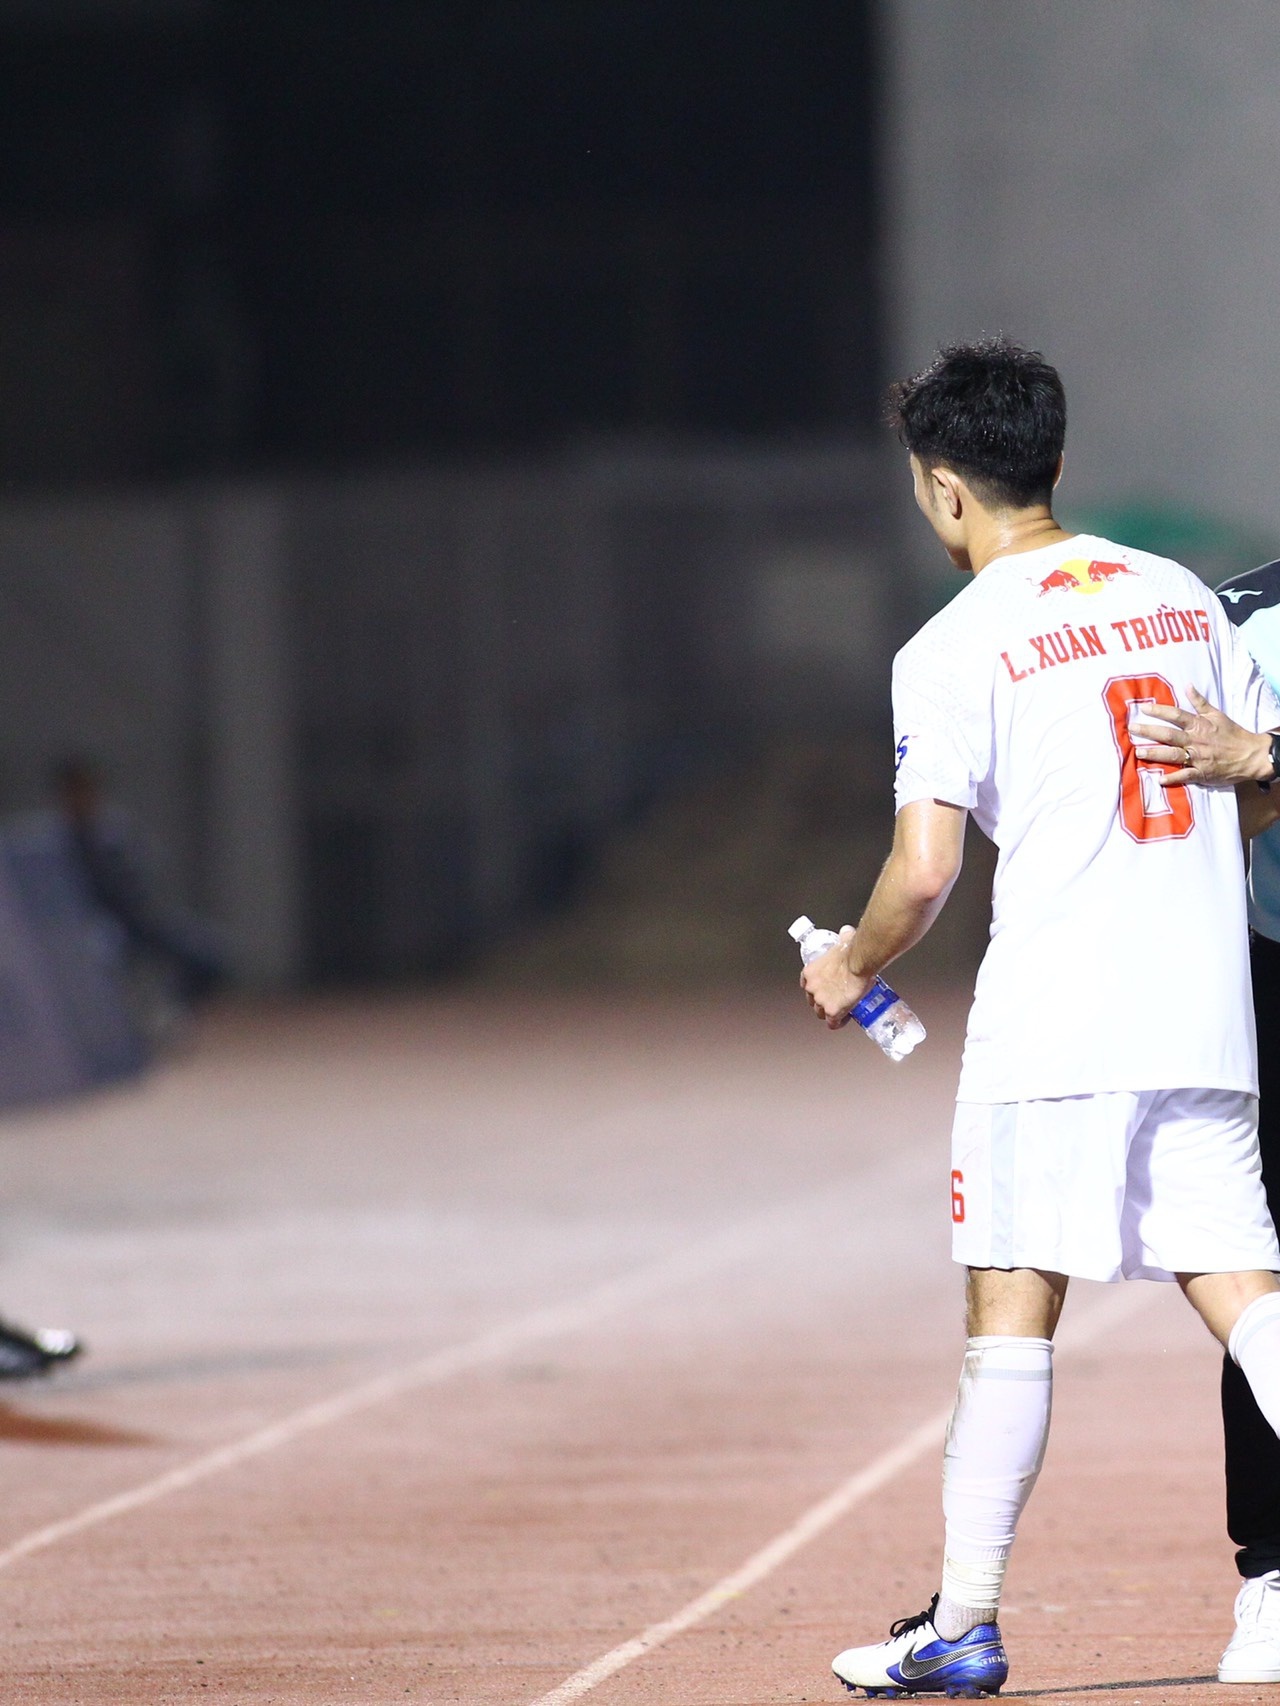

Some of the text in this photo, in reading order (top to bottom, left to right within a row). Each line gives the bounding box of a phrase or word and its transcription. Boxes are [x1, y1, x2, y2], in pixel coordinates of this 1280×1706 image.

[1001, 604, 1210, 682] L.XUÂN TRƯỜNG
[951, 1169, 965, 1224] 6
